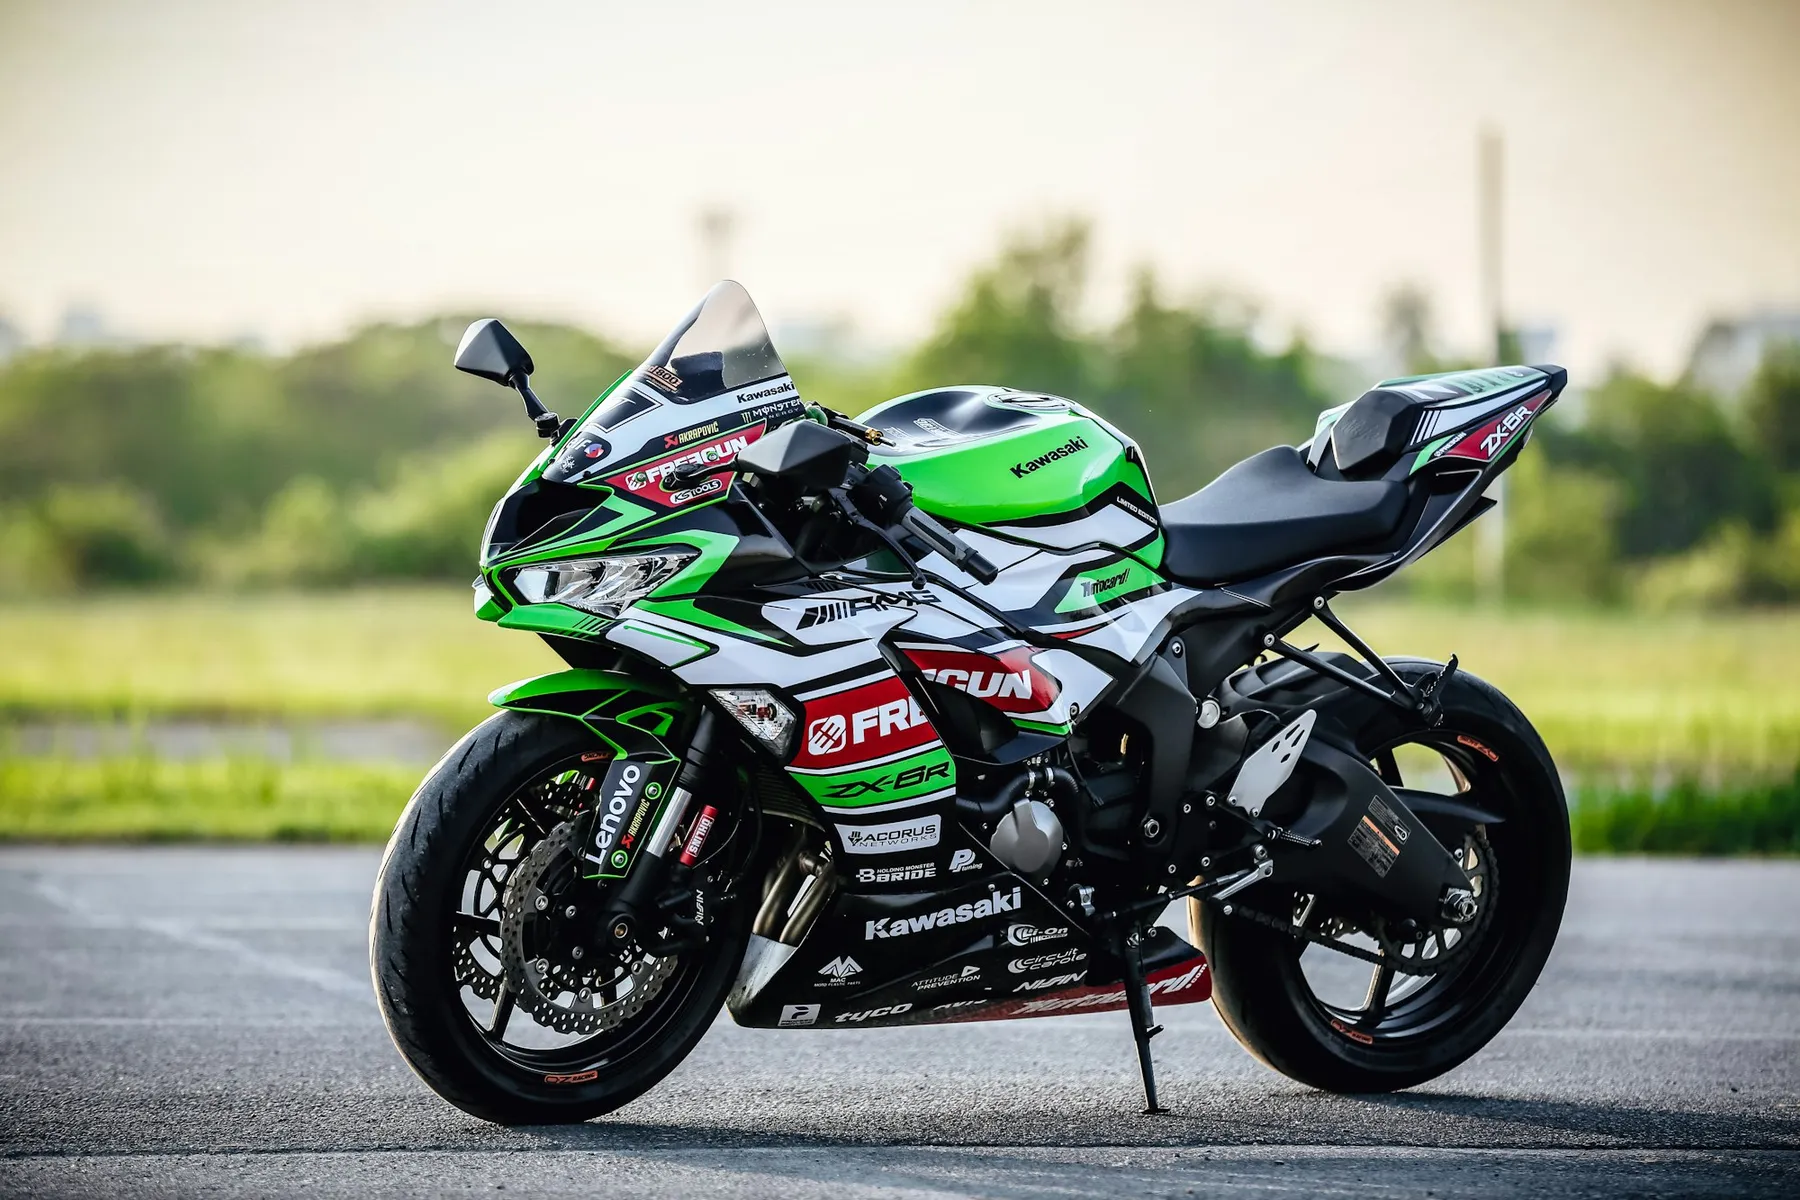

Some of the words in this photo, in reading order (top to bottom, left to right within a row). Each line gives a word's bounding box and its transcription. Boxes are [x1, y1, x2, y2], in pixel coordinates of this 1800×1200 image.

[736, 381, 796, 404] Kawasaki
[1009, 435, 1089, 479] Kawasaki
[1116, 496, 1138, 513] LIMITED
[821, 761, 951, 799] ZX-6R
[584, 765, 641, 865] Lenovo
[858, 833, 937, 848] NETWORKS
[863, 824, 936, 842] ACORUS
[877, 865, 904, 874] HOLDING
[905, 862, 935, 871] MONSTER
[864, 886, 1022, 941] Kawasaki
[911, 973, 959, 988] ATTITUDE
[916, 974, 981, 991] PREVENTION
[834, 1003, 914, 1023] tyco
